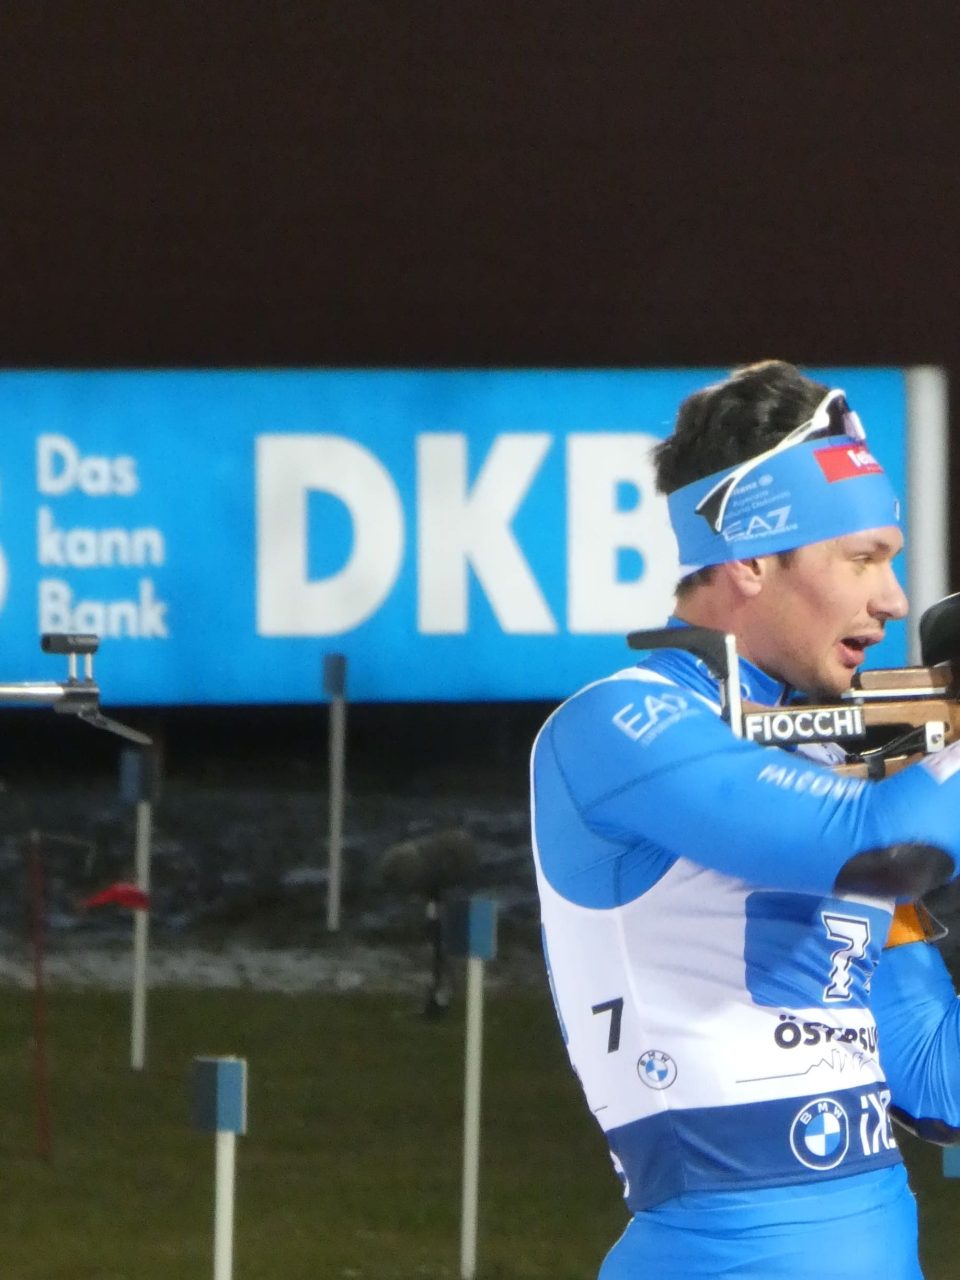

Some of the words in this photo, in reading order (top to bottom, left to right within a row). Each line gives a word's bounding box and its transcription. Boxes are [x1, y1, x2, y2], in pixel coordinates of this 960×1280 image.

[37, 434, 139, 496] Das
[37, 506, 165, 567] kann
[255, 432, 680, 637] DKB
[38, 578, 168, 638] Bank
[745, 707, 863, 742] FIOCCHI
[821, 911, 871, 1003] 7
[591, 997, 624, 1054] 7
